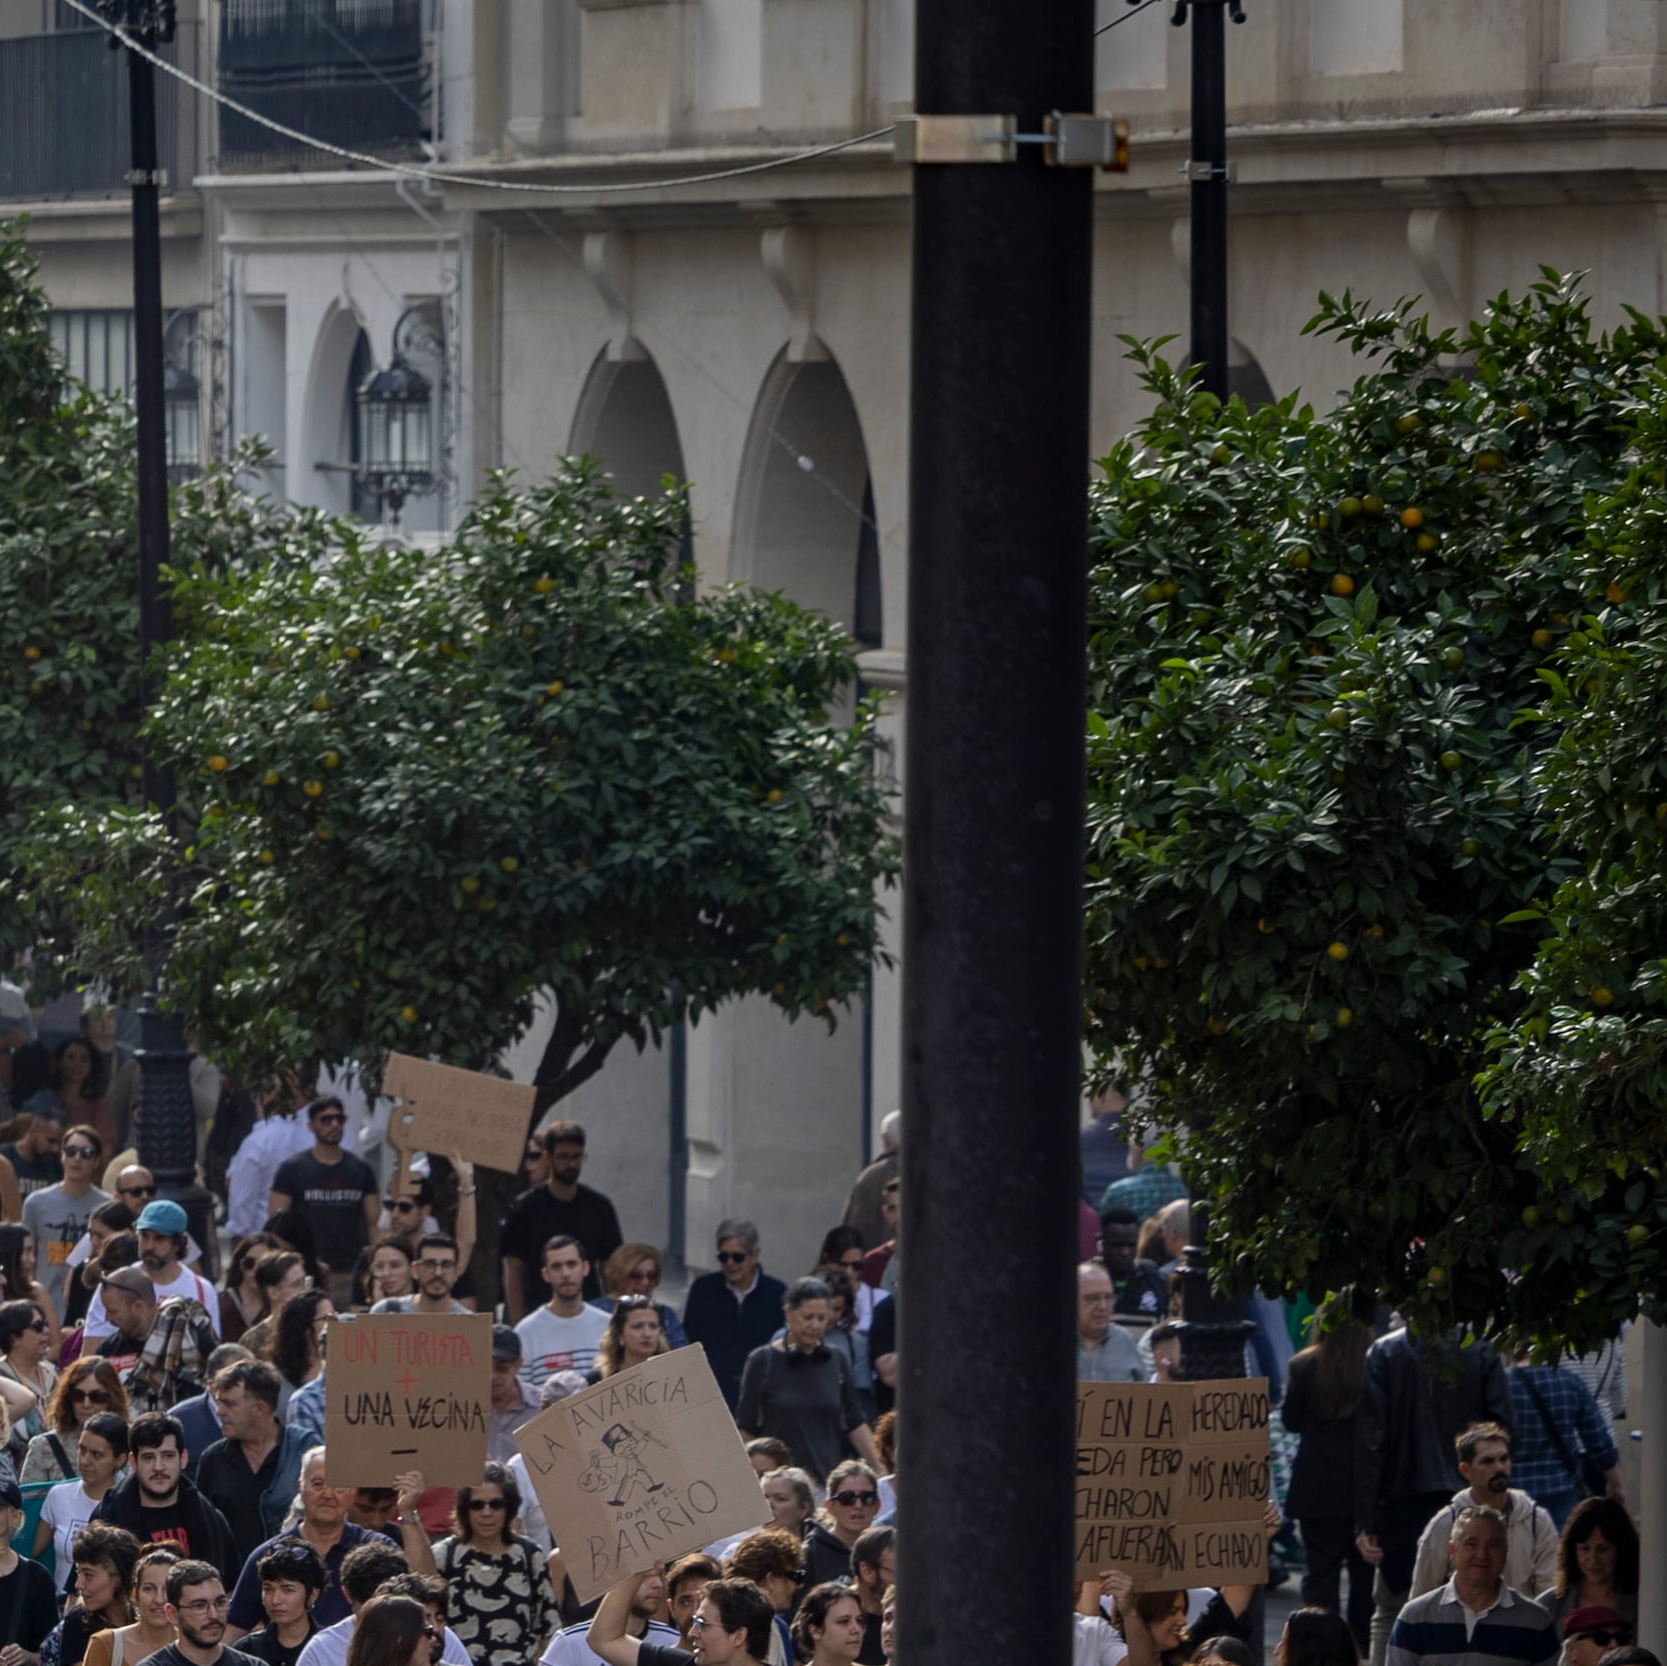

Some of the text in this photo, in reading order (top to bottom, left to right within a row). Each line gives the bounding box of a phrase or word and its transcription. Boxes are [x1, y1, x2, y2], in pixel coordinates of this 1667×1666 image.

[343, 1329, 476, 1369] UN TURISTA
[344, 1391, 486, 1433] UNA VECINA
[529, 1376, 688, 1476] LA AVARICIA
[1075, 1389, 1174, 1439] Í EN LA
[1192, 1391, 1268, 1432] HEREDADO
[1075, 1446, 1183, 1477] EDA PERO
[1188, 1455, 1216, 1501] MIS
[615, 1496, 659, 1522] ROMPE
[1075, 1486, 1171, 1519] CHARON
[587, 1480, 718, 1584] BARRIO
[1195, 1531, 1262, 1569] ECHADO
